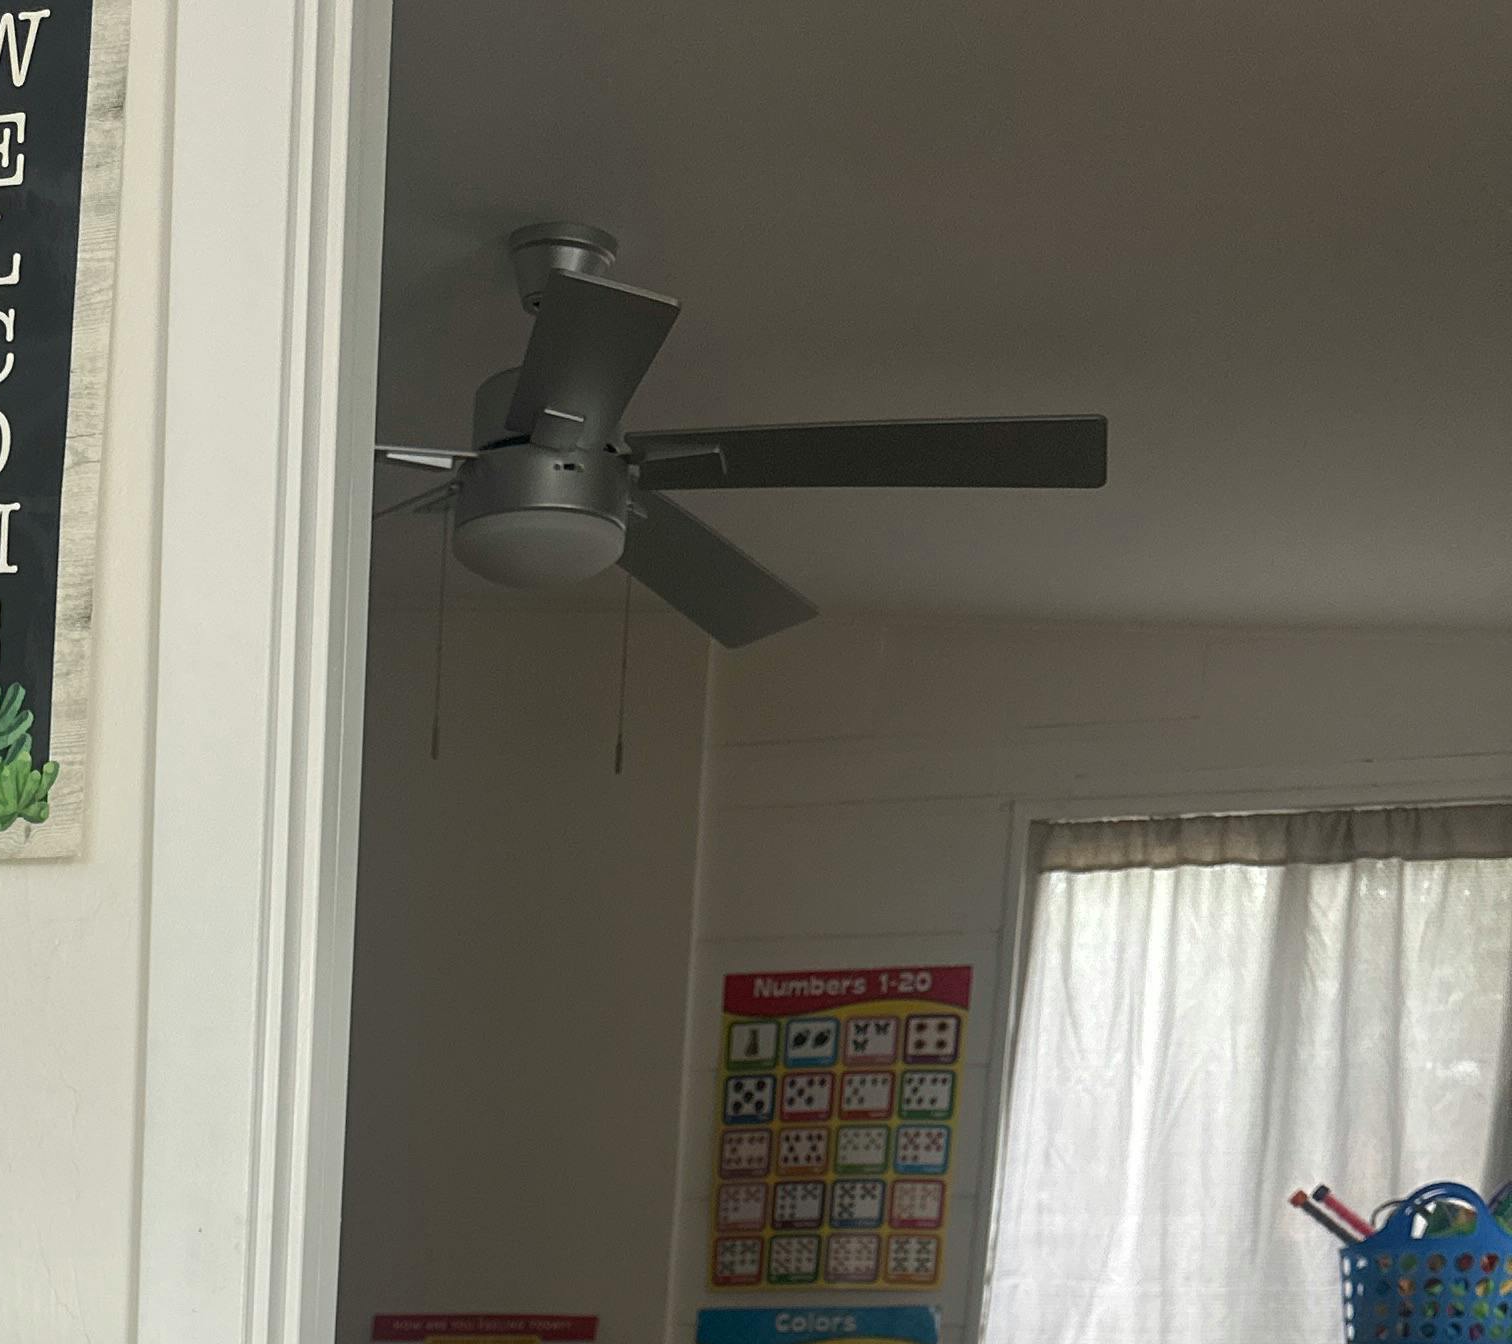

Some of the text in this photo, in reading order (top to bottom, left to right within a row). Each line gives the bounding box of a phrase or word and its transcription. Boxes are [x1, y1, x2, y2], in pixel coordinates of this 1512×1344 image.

[753, 971, 932, 999] Numbers 1-20
[775, 1312, 857, 1334] Colors
